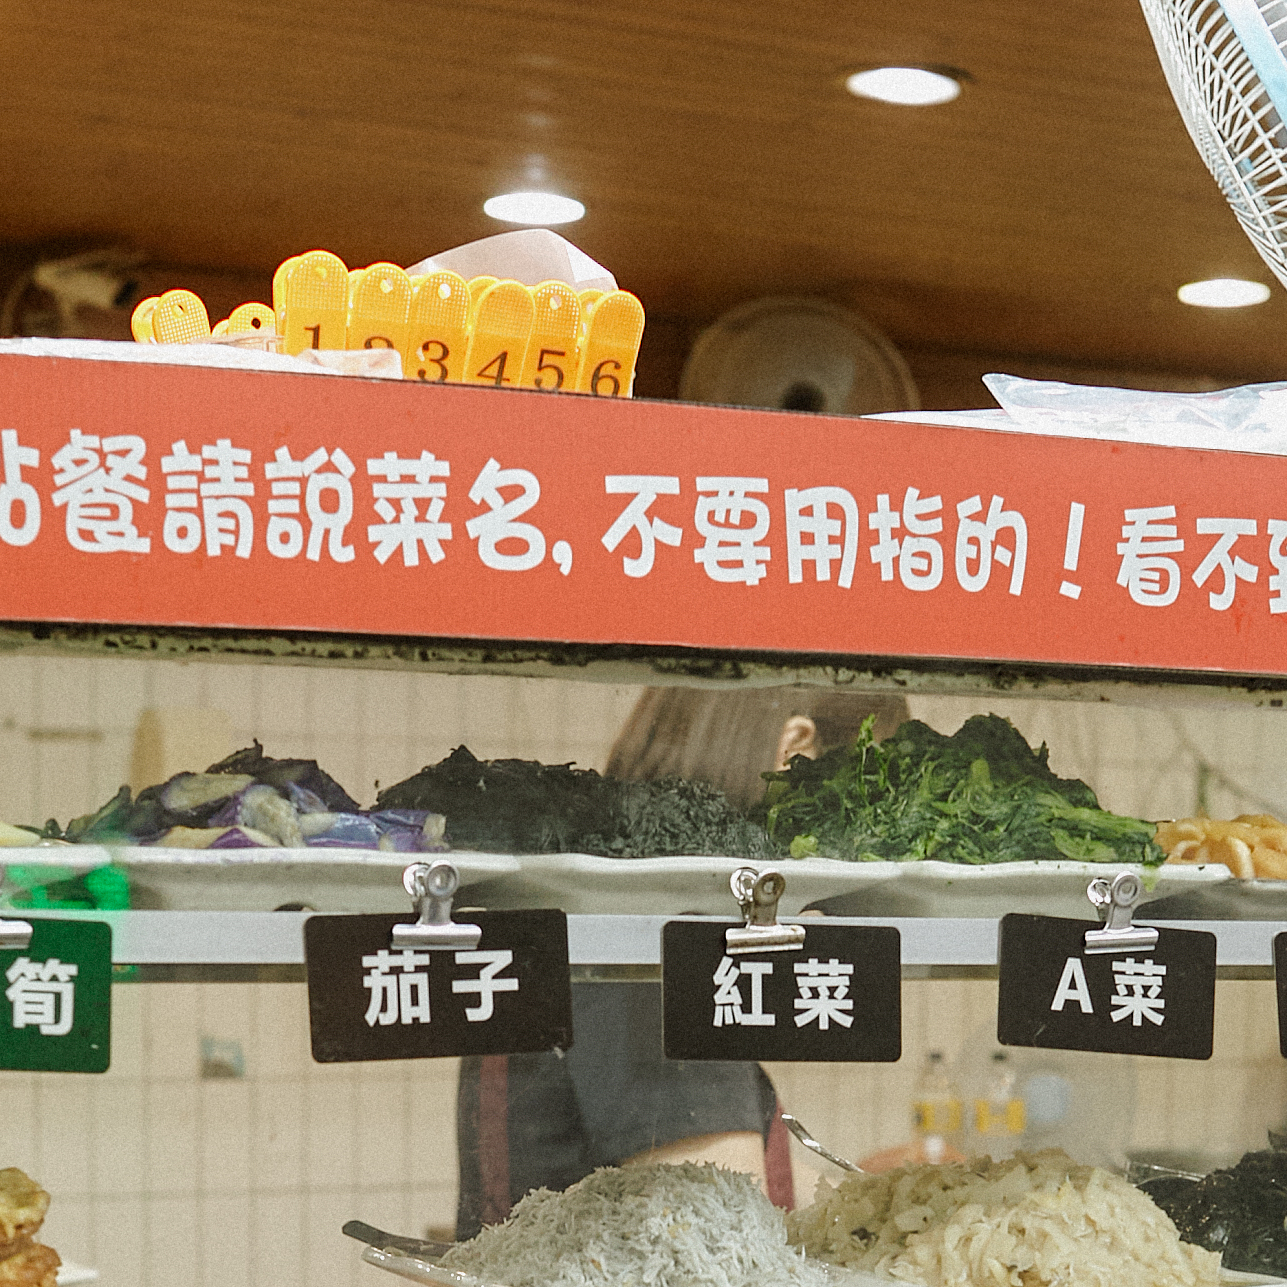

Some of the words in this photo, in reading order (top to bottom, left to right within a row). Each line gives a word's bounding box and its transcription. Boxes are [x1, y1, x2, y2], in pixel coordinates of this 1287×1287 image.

[418, 341, 450, 385] 3
[477, 350, 510, 388] 4
[534, 349, 566, 392] 5
[590, 360, 620, 397] 6
[362, 949, 519, 1027] 茄子
[712, 956, 855, 1030] 紅菜
